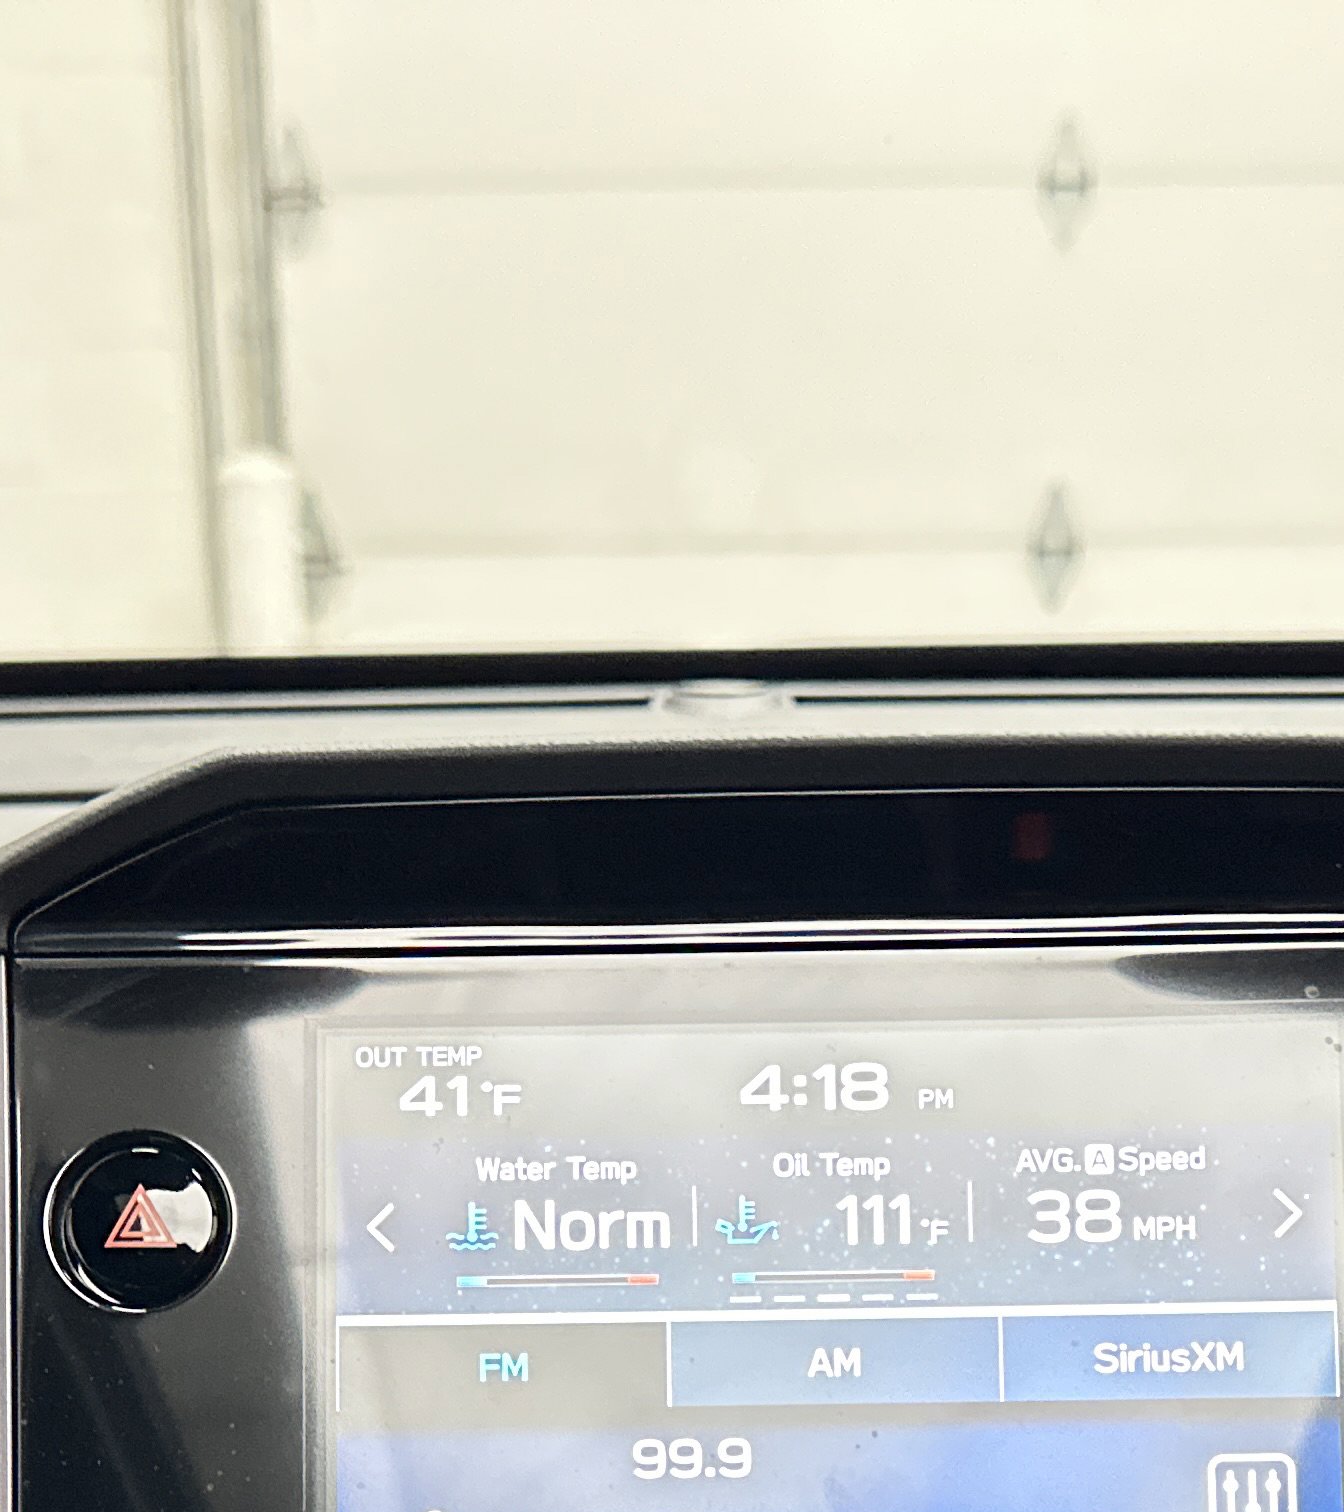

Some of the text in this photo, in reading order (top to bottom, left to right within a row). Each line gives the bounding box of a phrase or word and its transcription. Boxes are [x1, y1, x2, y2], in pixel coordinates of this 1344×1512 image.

[355, 1045, 484, 1068] OUT TEMP
[739, 1061, 954, 1112] 4:18 PM
[475, 1155, 637, 1184] Water Temp
[772, 1151, 892, 1182] Oil Temp
[1016, 1147, 1082, 1173] AVG.
[1117, 1146, 1207, 1174] Speed
[513, 1199, 671, 1251] Norm
[1026, 1188, 1197, 1244] 38 MPH
[479, 1352, 529, 1382] FM
[807, 1348, 862, 1379] AM
[1093, 1341, 1245, 1374] SiriusXM
[631, 1437, 753, 1480] 99.9
